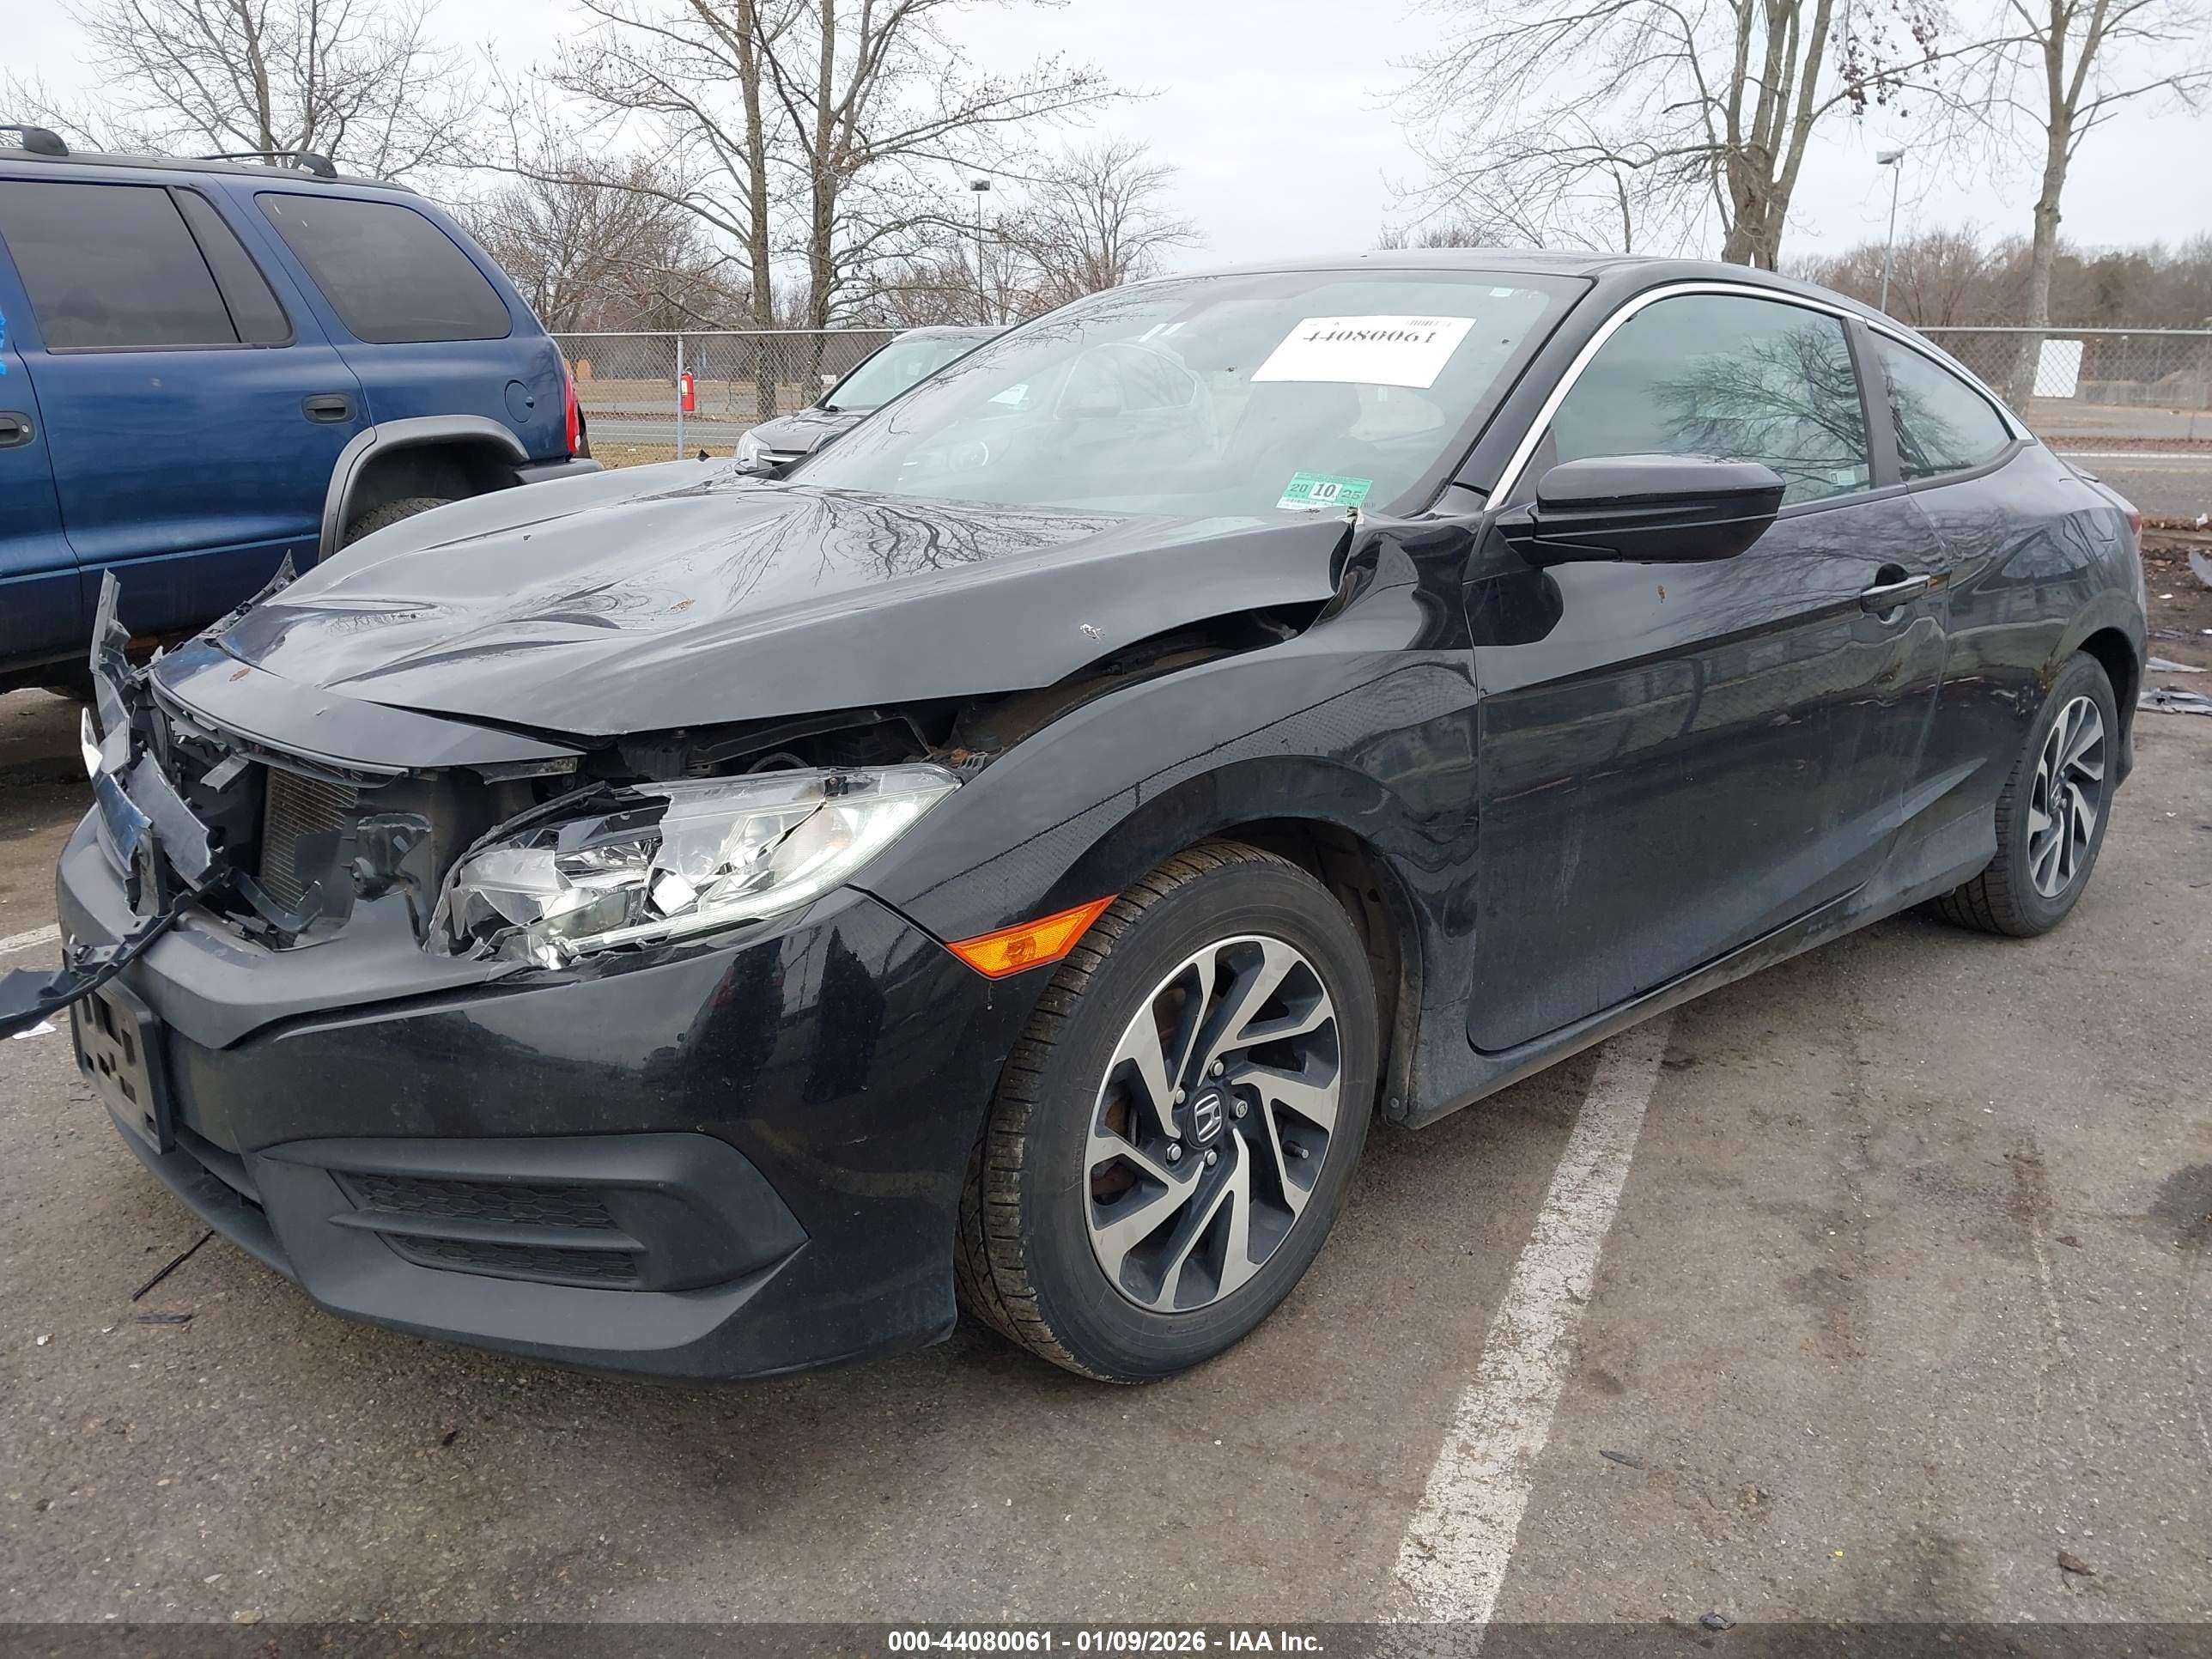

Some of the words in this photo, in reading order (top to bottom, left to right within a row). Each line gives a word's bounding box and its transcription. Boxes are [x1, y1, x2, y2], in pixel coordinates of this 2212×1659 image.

[1303, 331, 1437, 343] 44080061
[1290, 483, 1309, 493] 20
[1313, 483, 1336, 497] 10
